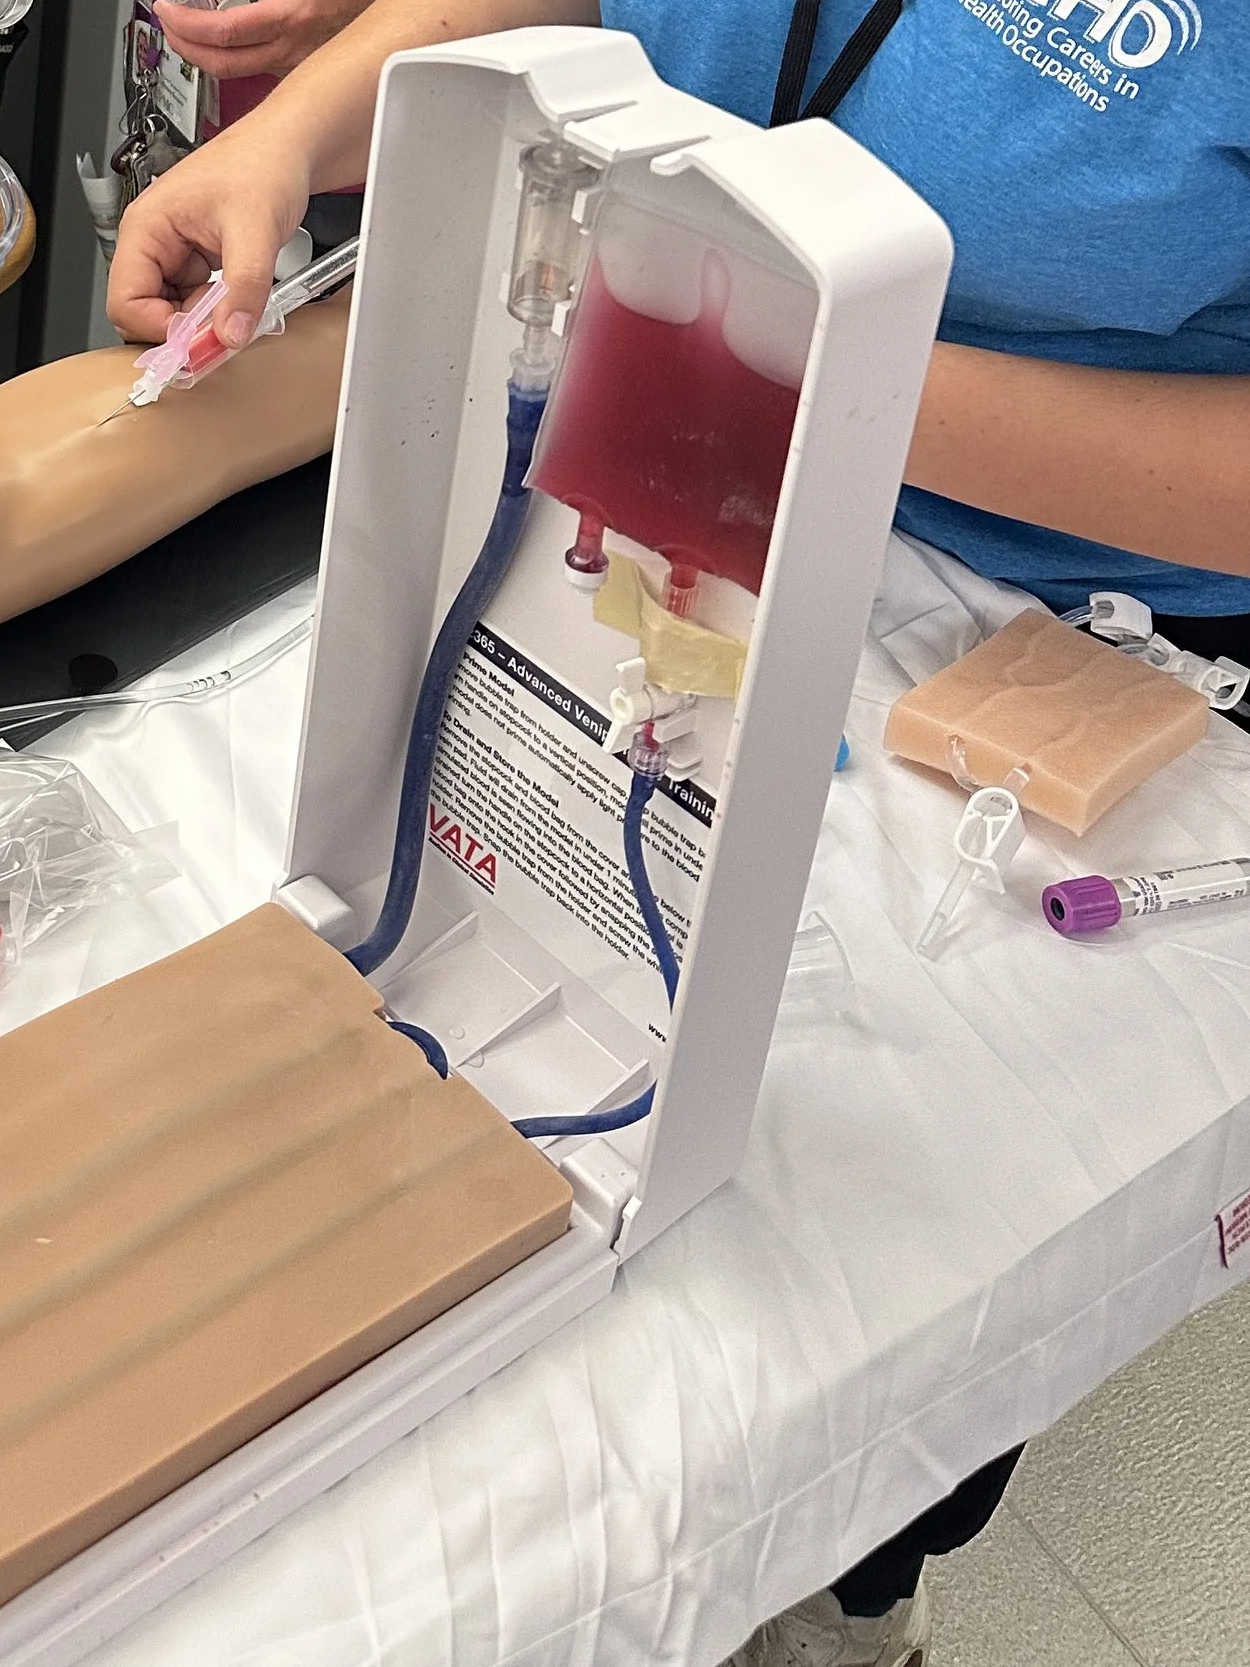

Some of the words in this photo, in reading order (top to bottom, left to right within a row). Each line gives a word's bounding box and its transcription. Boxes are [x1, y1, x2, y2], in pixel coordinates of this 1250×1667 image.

[1002, 24, 1110, 113] Occupations
[1046, 26, 1113, 85] Careers
[1113, 73, 1140, 100] in
[462, 650, 487, 676] Prime
[488, 670, 515, 698] Model
[471, 629, 497, 655] 365
[507, 655, 573, 711] Advanced
[452, 716, 475, 742] Drain
[475, 736, 492, 755] and
[492, 748, 516, 774] Store
[516, 767, 531, 786] the
[531, 779, 560, 809] Model
[428, 804, 498, 882] VATA
